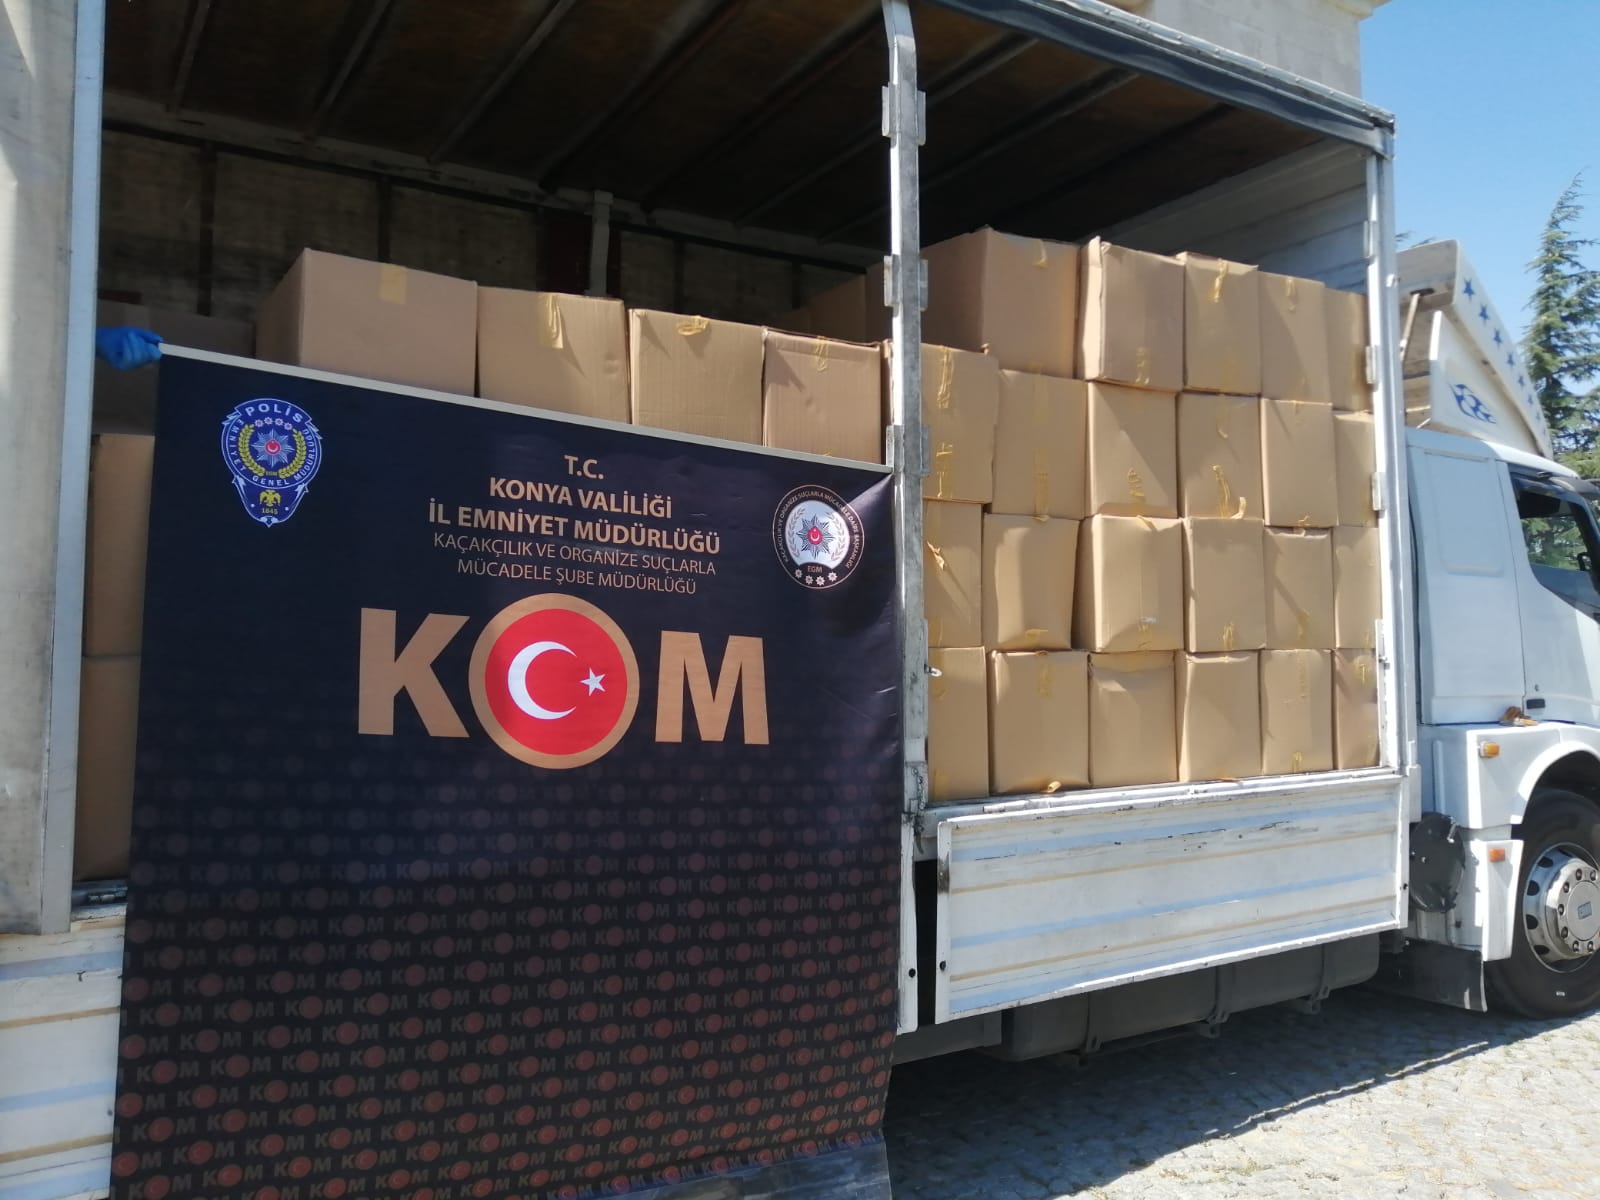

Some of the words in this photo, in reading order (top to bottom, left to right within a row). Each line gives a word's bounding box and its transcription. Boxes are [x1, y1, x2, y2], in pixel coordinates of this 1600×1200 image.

[245, 404, 303, 423] POLİS
[252, 475, 290, 486] GENEL
[564, 455, 604, 479] T.C.
[490, 477, 572, 506] KONYA
[579, 488, 672, 519] VALİLİĞİ
[429, 498, 451, 524] İL
[458, 506, 568, 537] EMNİYET
[574, 519, 720, 554] MÜDÜRLÜĞÜ
[434, 532, 532, 557] KAÇAKÇILIK
[536, 542, 556, 558] VE
[560, 546, 638, 568] ORGANİZE
[642, 555, 716, 575] SUÇLARLA
[458, 559, 551, 581] MÜCADELE
[556, 569, 594, 586] ŞUBE
[598, 572, 696, 594] MÜDÜRLÜĞÜ
[358, 593, 770, 769] KOM
